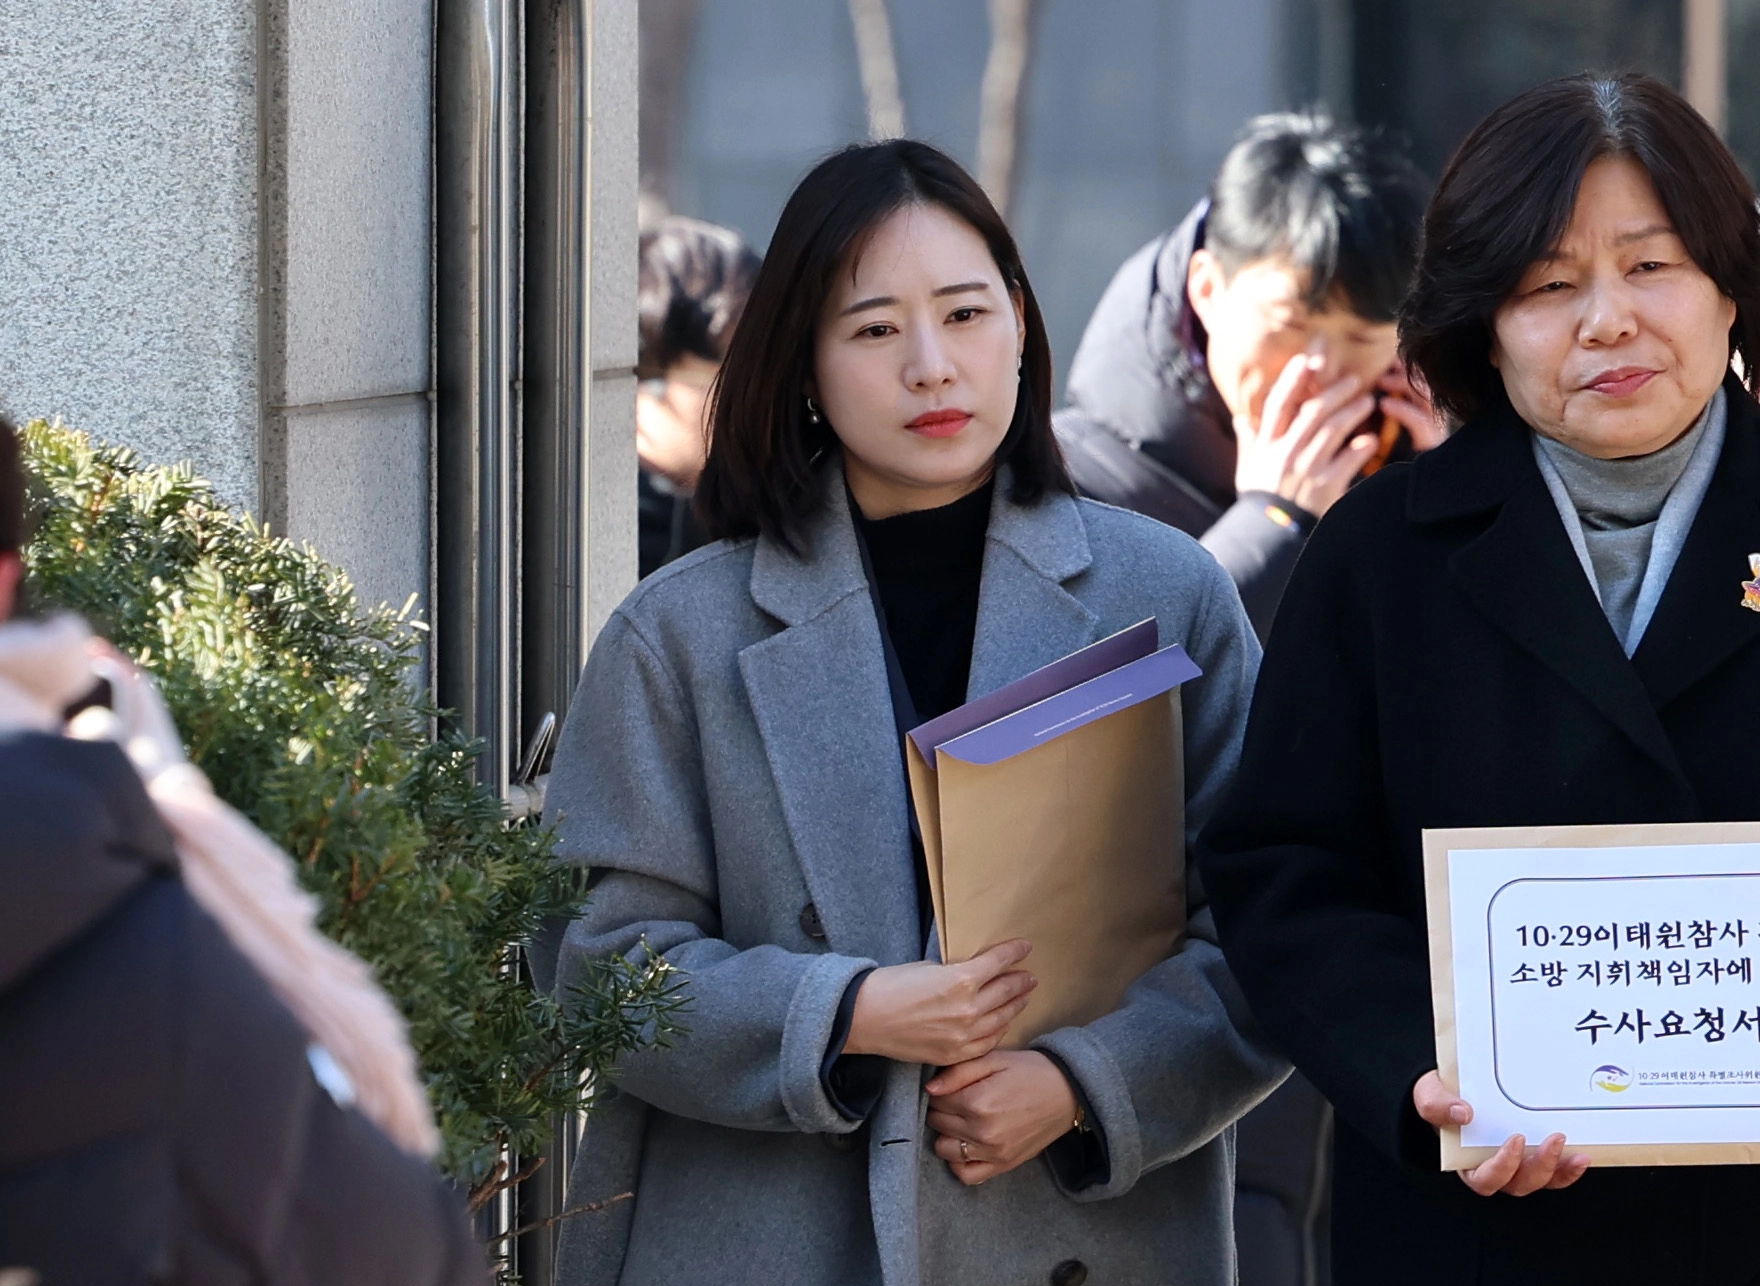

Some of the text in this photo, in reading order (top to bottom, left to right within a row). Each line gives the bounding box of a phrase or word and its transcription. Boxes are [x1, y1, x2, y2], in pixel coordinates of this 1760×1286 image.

[1517, 919, 1749, 950] 10·29이태원참사
[1510, 961, 1567, 987] 소방
[1577, 957, 1751, 986] 지휘책임자에
